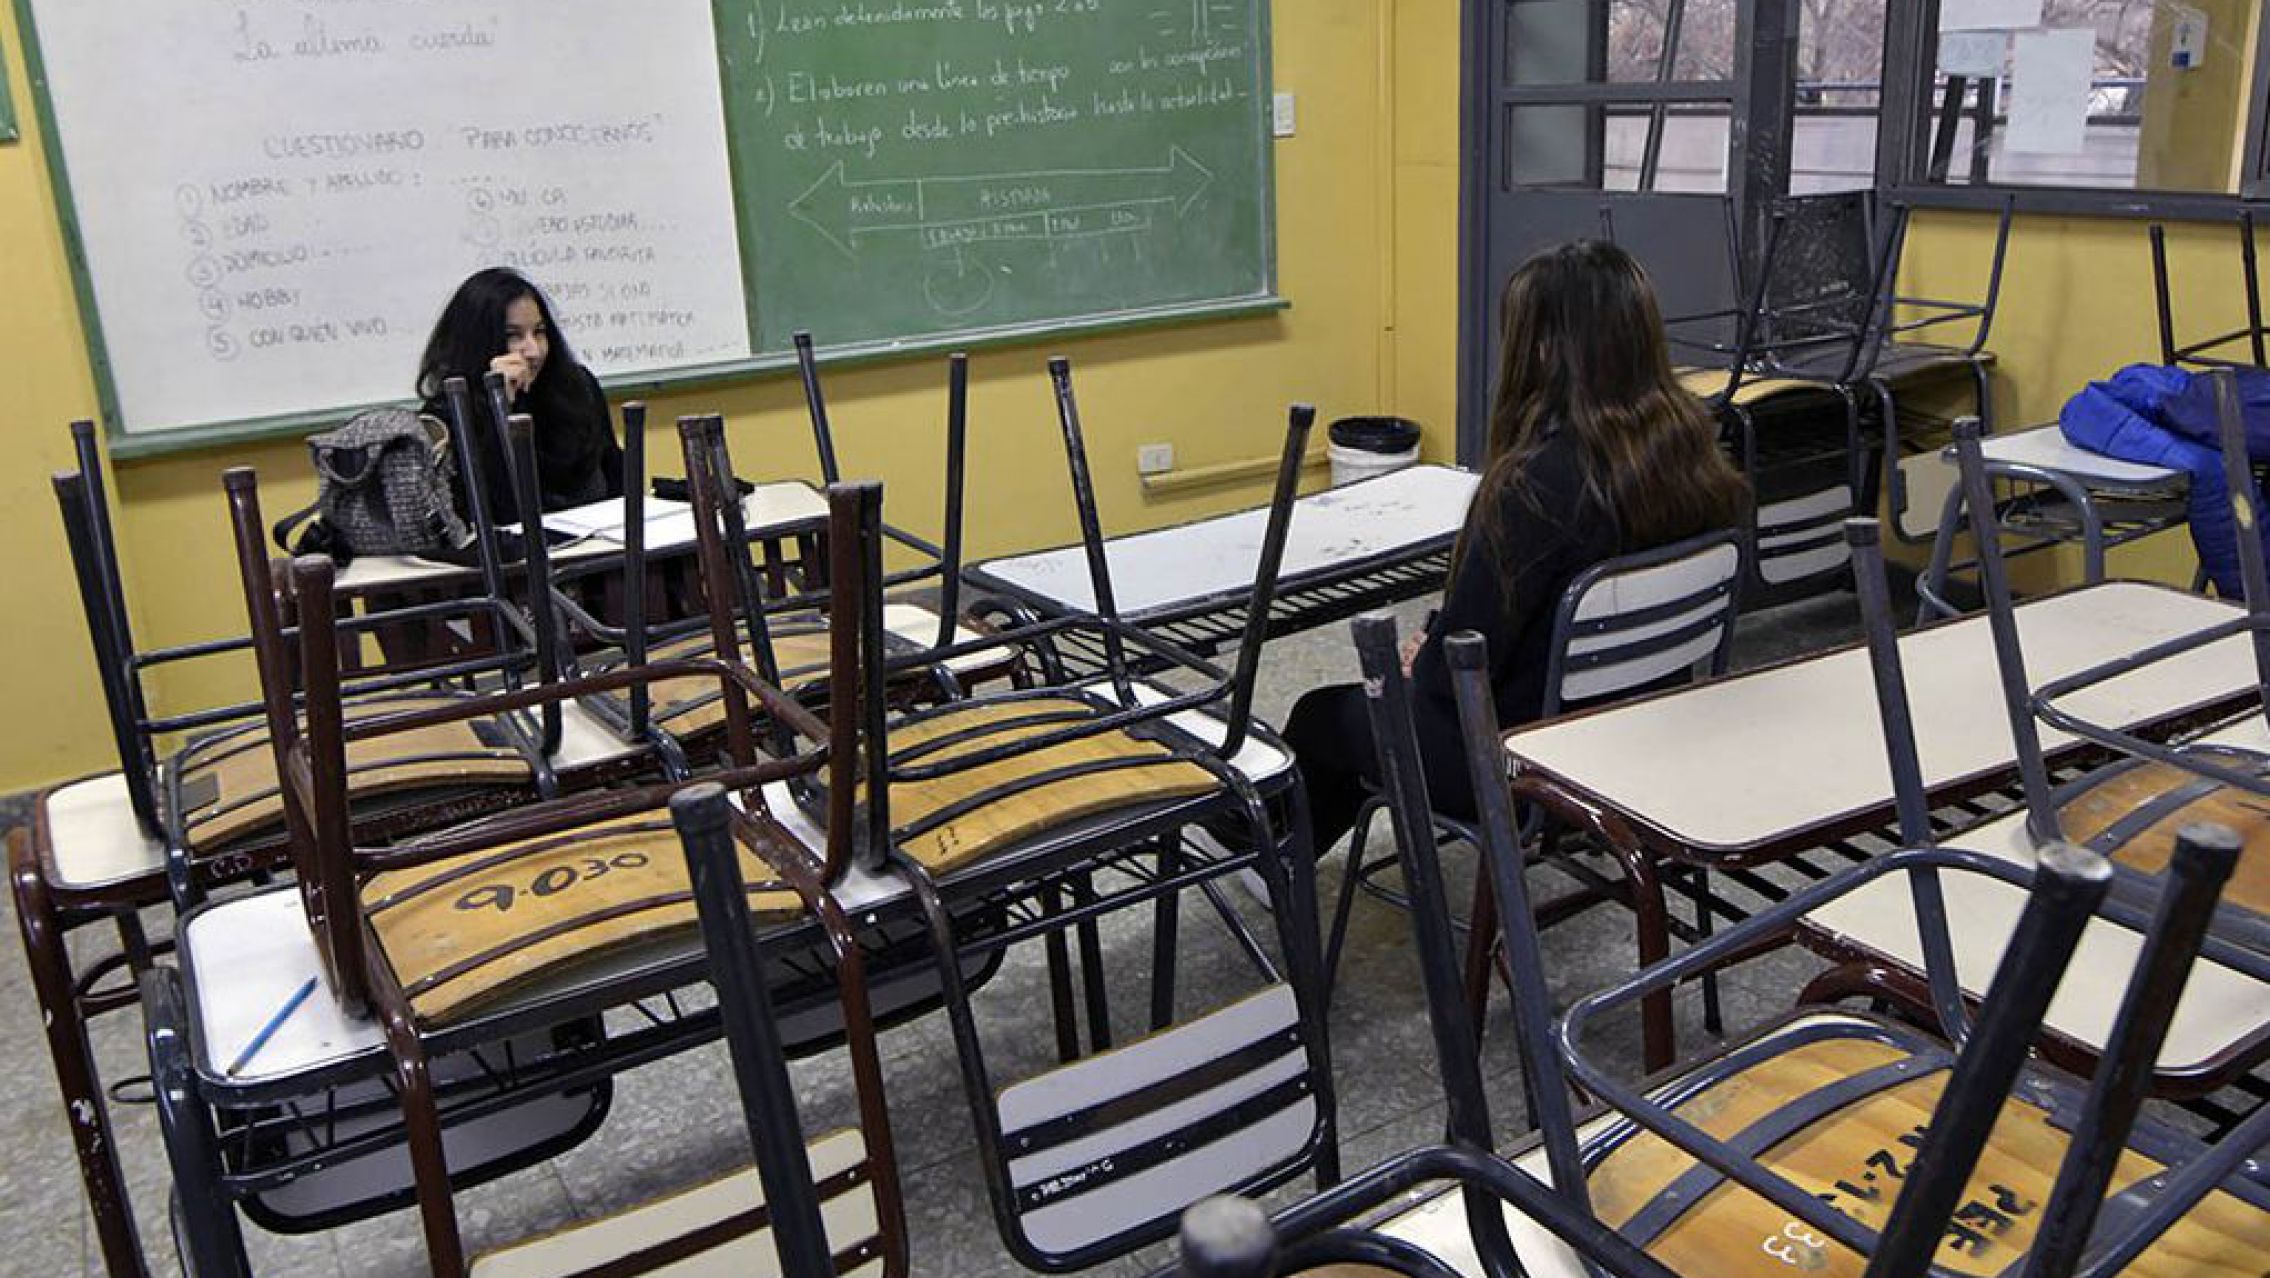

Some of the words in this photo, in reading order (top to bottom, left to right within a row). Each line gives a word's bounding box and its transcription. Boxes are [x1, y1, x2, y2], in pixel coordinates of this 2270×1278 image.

[788, 71, 887, 103] Elaboren
[902, 107, 953, 140] desde
[262, 128, 425, 159] CUESTIONARIO
[209, 175, 289, 203] NOMBRE
